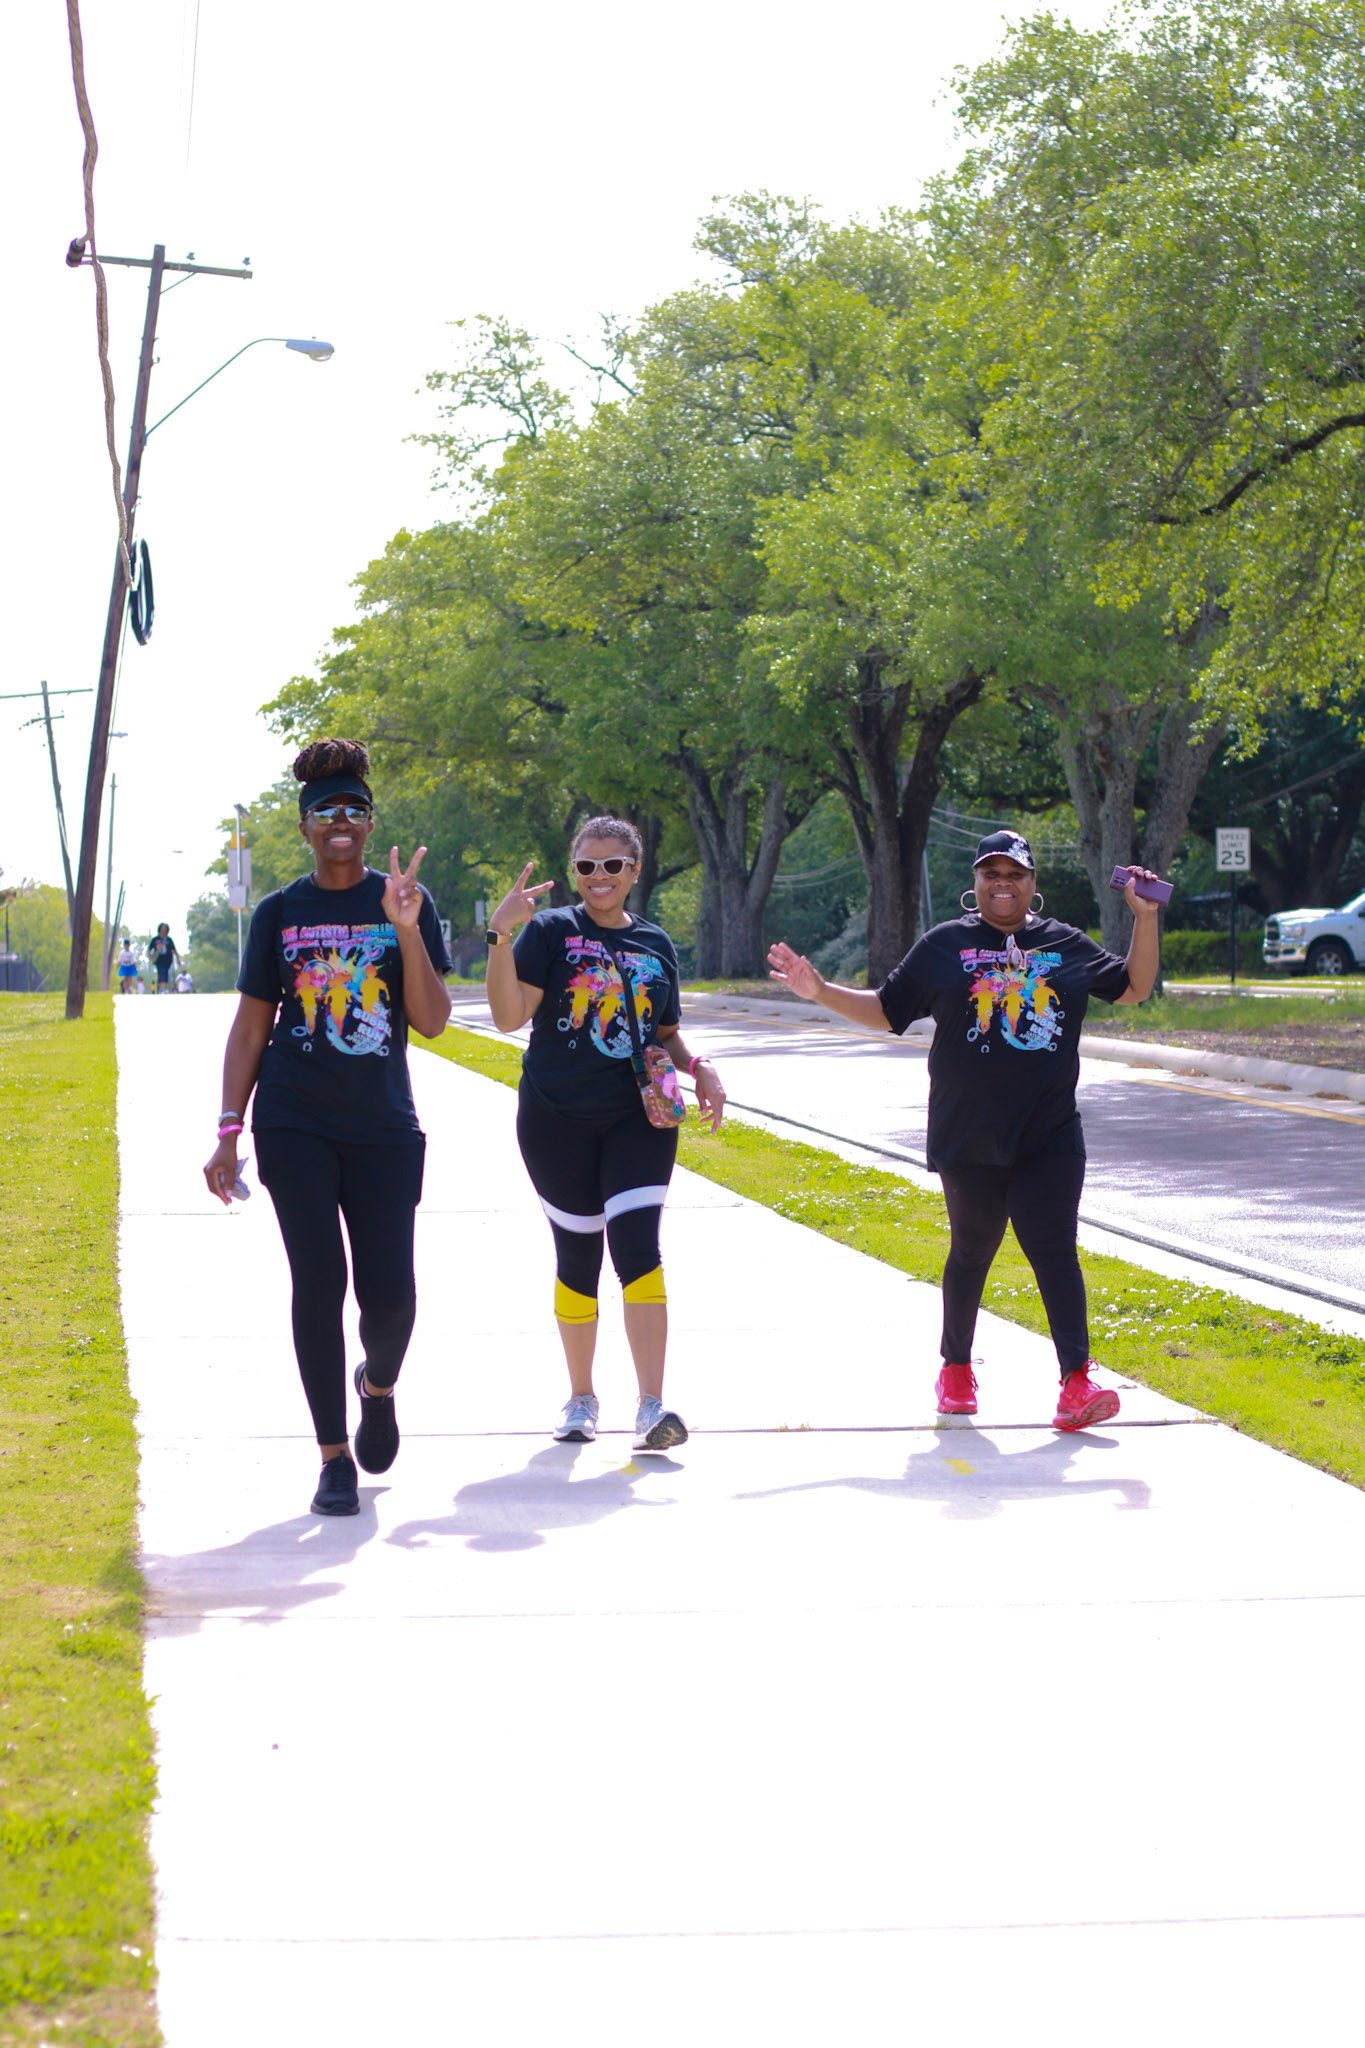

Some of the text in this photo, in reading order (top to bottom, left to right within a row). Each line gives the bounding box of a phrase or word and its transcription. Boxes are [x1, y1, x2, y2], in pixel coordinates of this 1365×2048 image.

[1221, 850, 1246, 865] 25
[357, 1022, 386, 1043] RUN
[1026, 1010, 1063, 1036] BUBBLE
[1030, 1023, 1053, 1041] RUN
